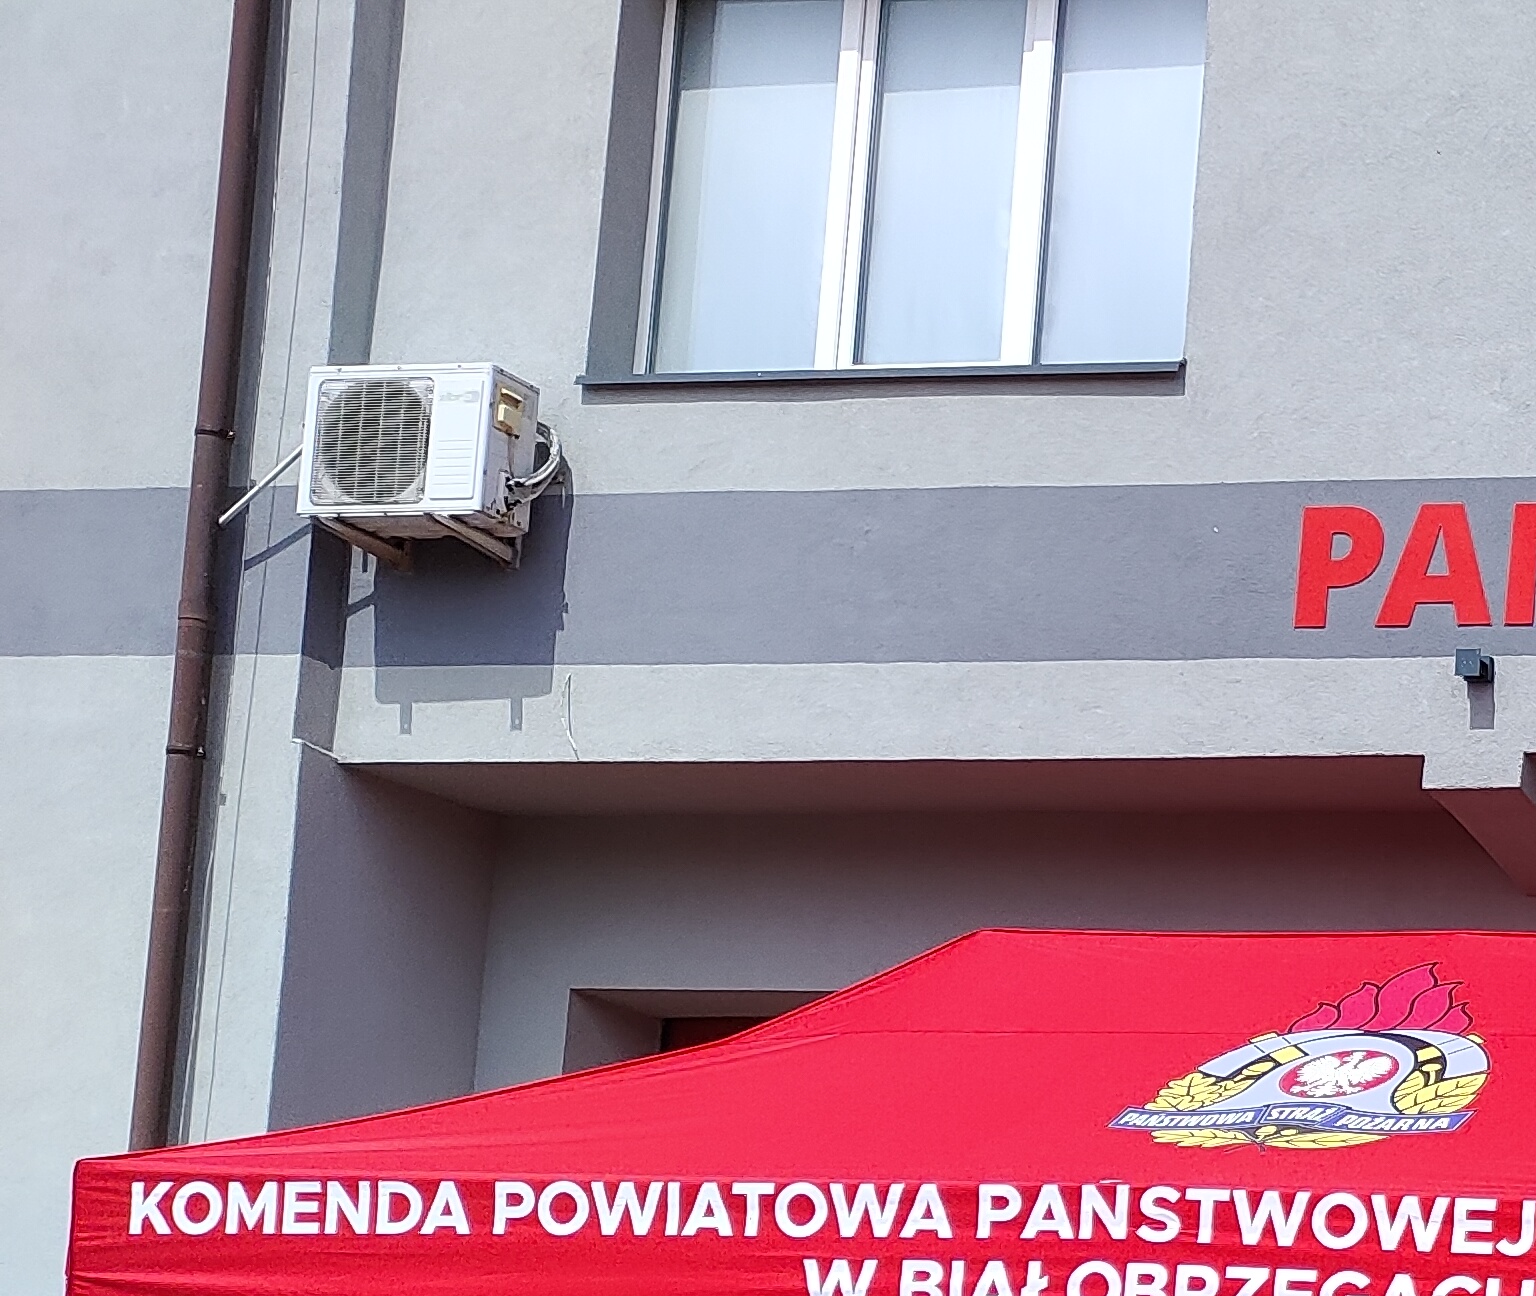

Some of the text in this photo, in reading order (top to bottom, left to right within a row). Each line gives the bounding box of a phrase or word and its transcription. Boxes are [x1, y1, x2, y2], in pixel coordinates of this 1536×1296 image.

[1118, 1105, 1451, 1131] PAŃSTWOWA STRAŻ POŻARNA
[127, 1180, 471, 1236] KOMENDA
[492, 1180, 954, 1239] POWIATOWA
